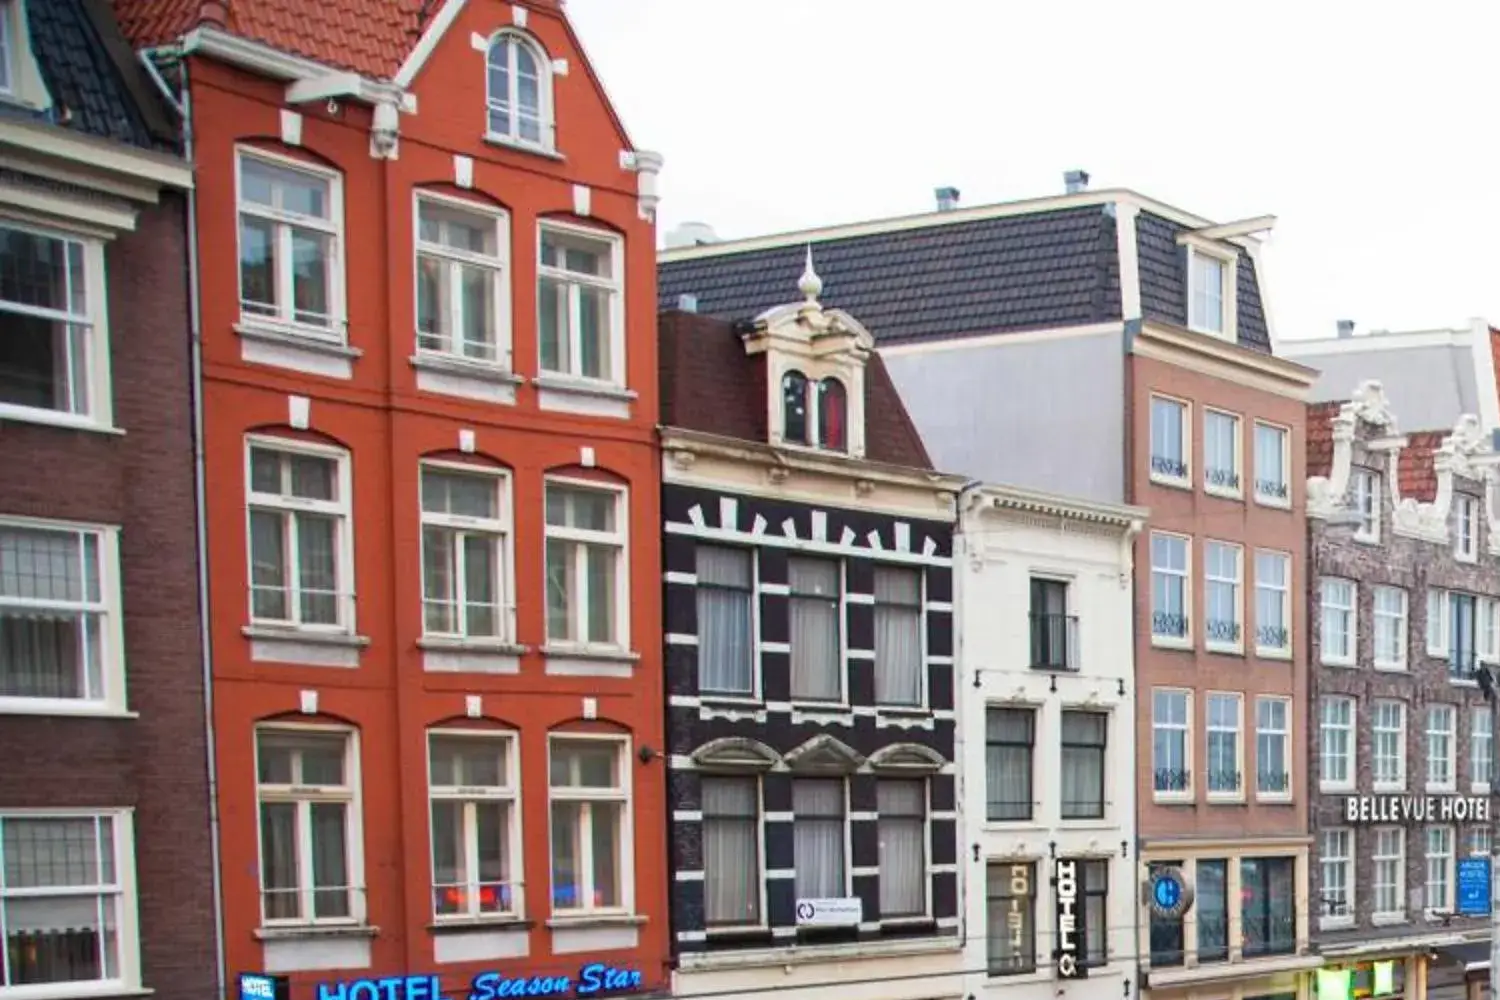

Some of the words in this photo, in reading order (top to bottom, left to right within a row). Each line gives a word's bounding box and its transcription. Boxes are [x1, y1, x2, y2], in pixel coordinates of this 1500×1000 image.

[1347, 796, 1436, 821] BELLEVUE
[1058, 860, 1078, 950] HOTEL
[577, 964, 642, 994] Star
